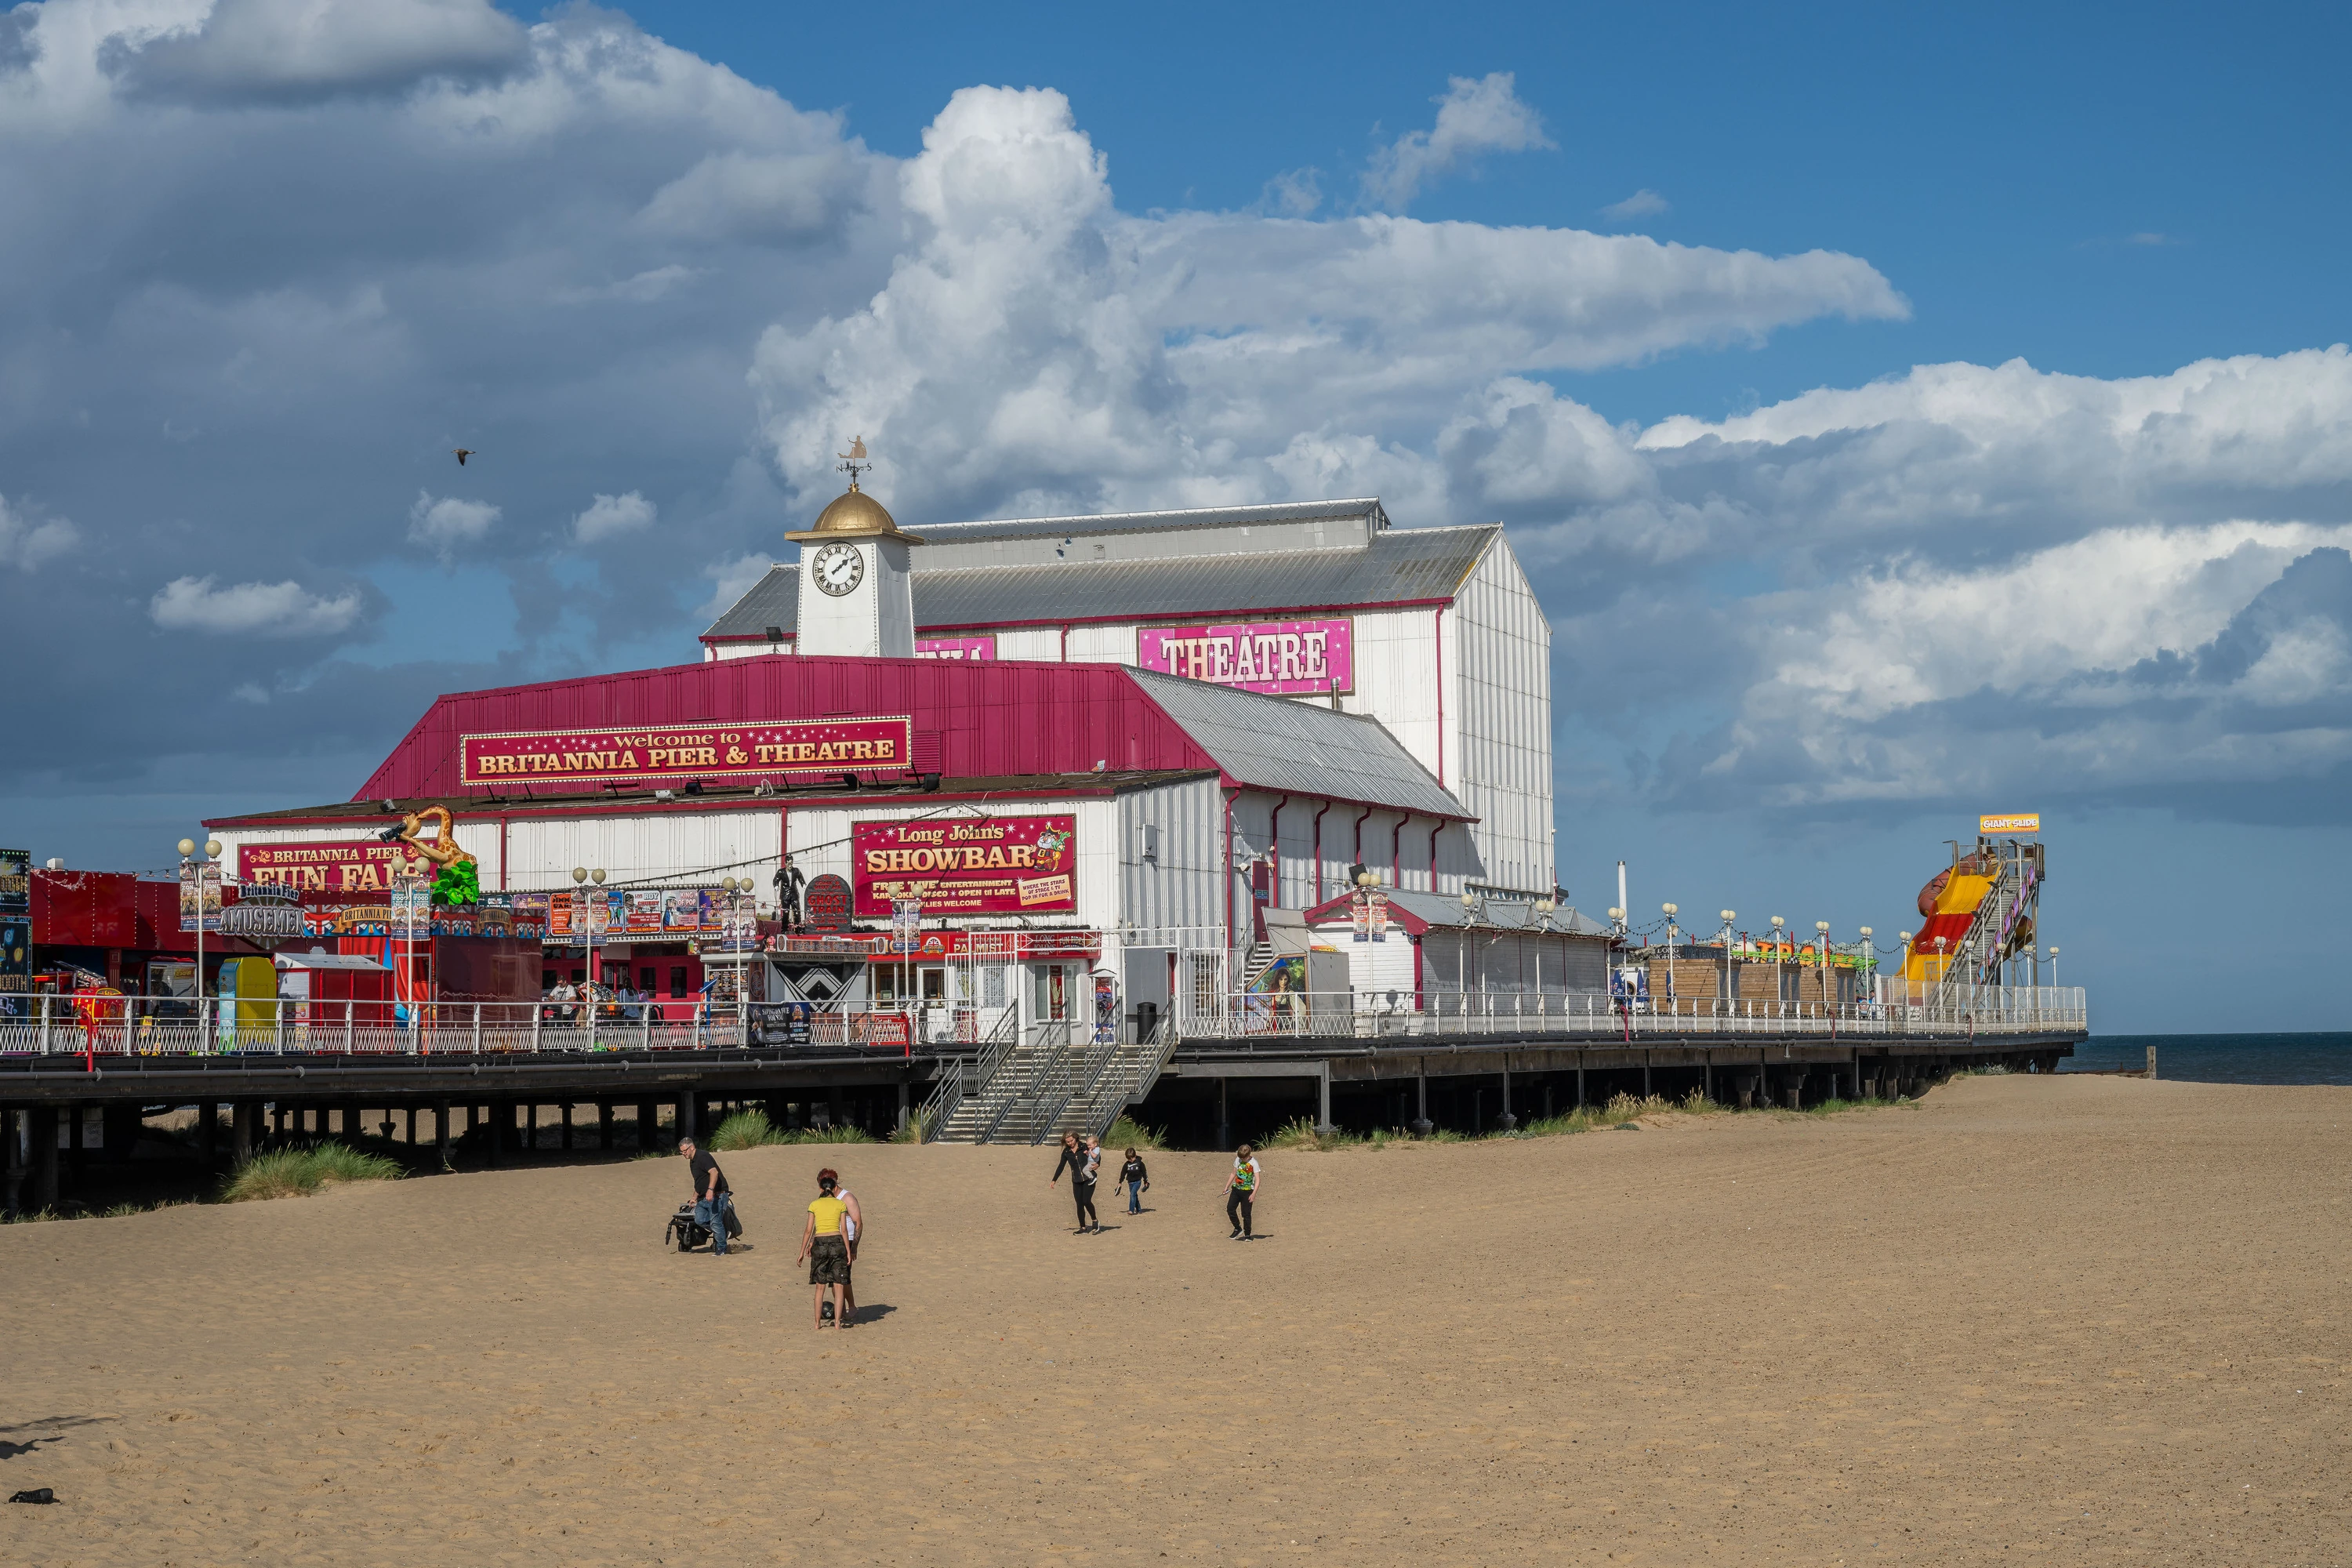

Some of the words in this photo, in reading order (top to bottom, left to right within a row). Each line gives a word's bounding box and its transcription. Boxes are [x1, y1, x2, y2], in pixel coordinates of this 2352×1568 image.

[1162, 630, 1328, 683] THEATRE
[614, 734, 714, 749] Welcome
[720, 731, 741, 745] to
[477, 750, 640, 775] BRITANNIA
[648, 746, 720, 768] PIER
[725, 745, 750, 765] &
[754, 739, 895, 764] THEATRE
[1983, 818, 2011, 829] GIANT
[2012, 818, 2037, 828] SLIDE
[898, 826, 944, 846] Long
[949, 824, 1004, 842] John's
[273, 848, 360, 863] BRITANNIA
[365, 846, 404, 861] PIER
[866, 844, 1035, 873] SHOWBAR
[251, 864, 329, 891] FUN
[873, 881, 904, 891] FRE
[940, 879, 1013, 888] ENTERTAINMENT
[238, 882, 281, 898] Britannia
[281, 885, 299, 902] Pier
[808, 895, 848, 906] GHOST
[873, 891, 914, 900] KAROKE
[922, 890, 949, 898] DISCO
[344, 909, 380, 921] BRITANNIA
[811, 906, 844, 915] TRAIN
[1035, 935, 1055, 945] LONG
[1059, 936, 1069, 946] FUN
